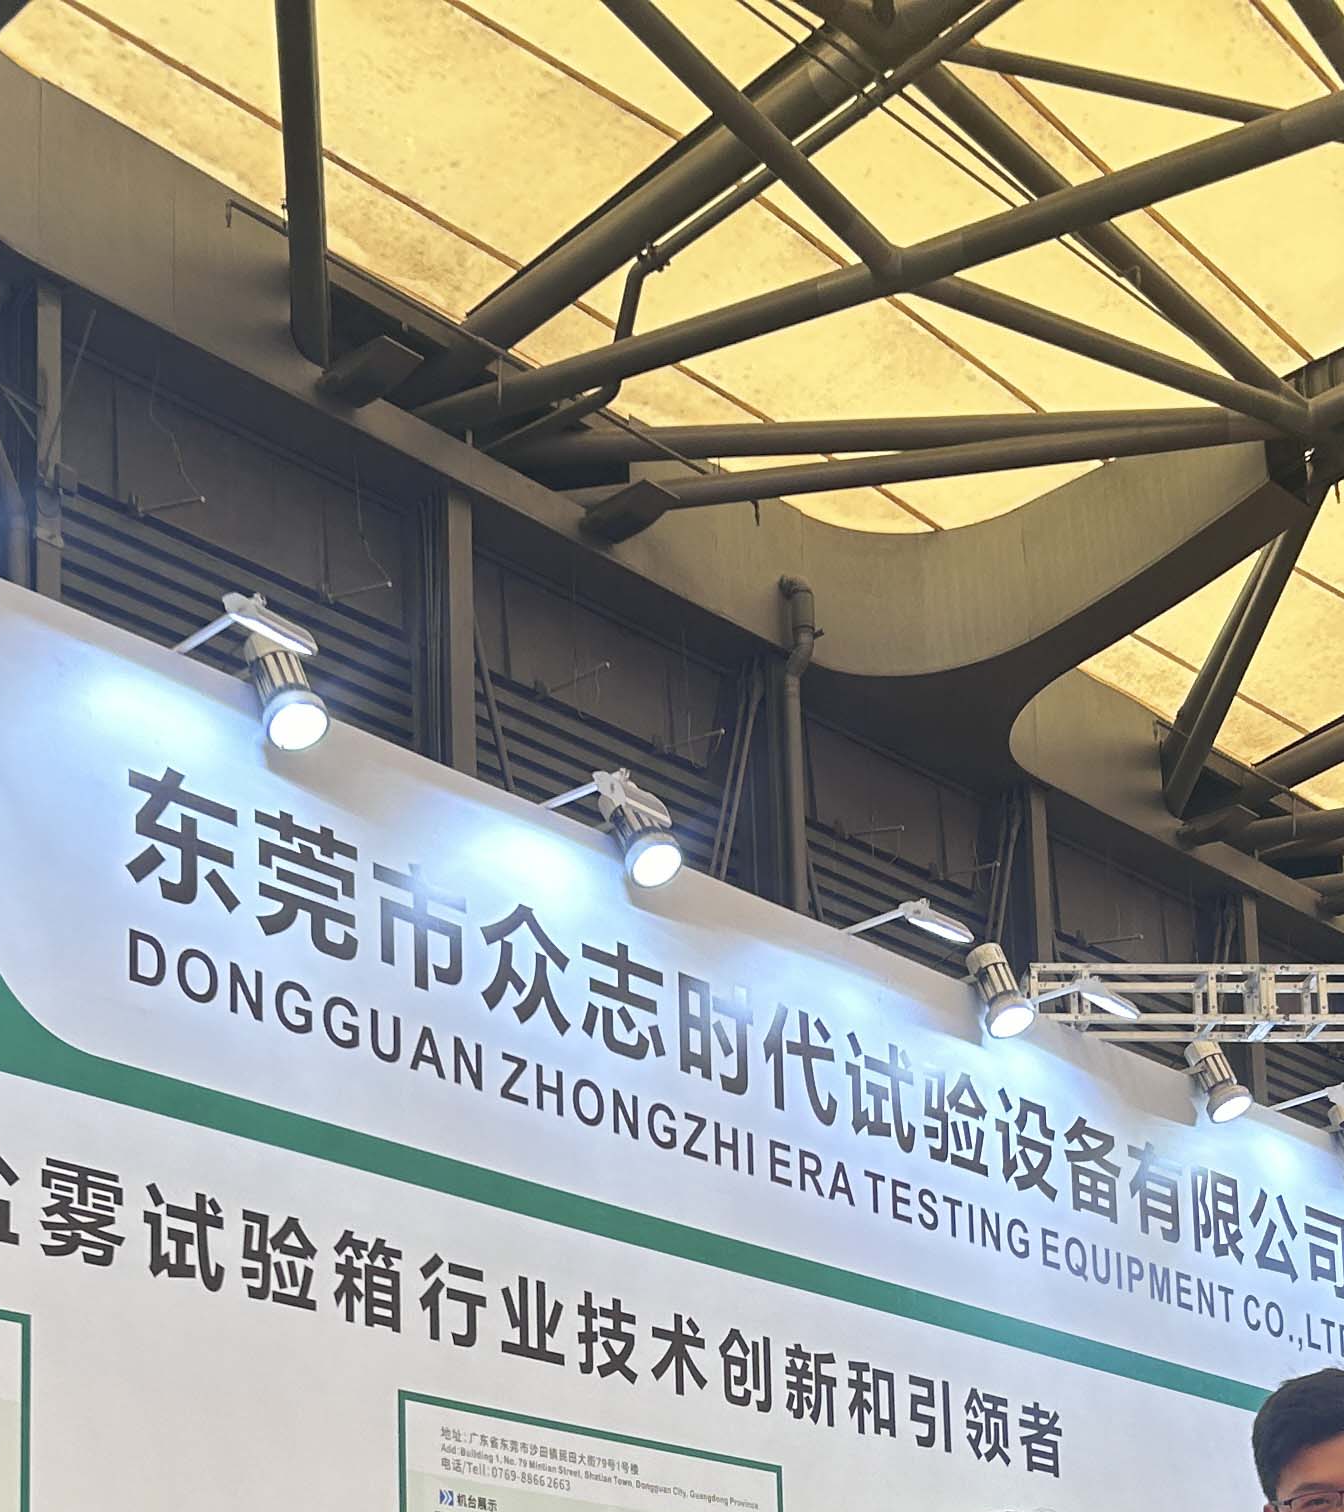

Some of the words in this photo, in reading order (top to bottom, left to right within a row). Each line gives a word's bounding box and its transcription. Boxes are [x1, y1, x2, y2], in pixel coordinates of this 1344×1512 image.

[128, 929, 484, 1092] DONGGUAN
[501, 1053, 756, 1178] ZHONGZHI
[769, 1128, 857, 1207] ERA
[863, 1166, 1031, 1260] TESTING
[1039, 1228, 1235, 1329] EQUIPMENT
